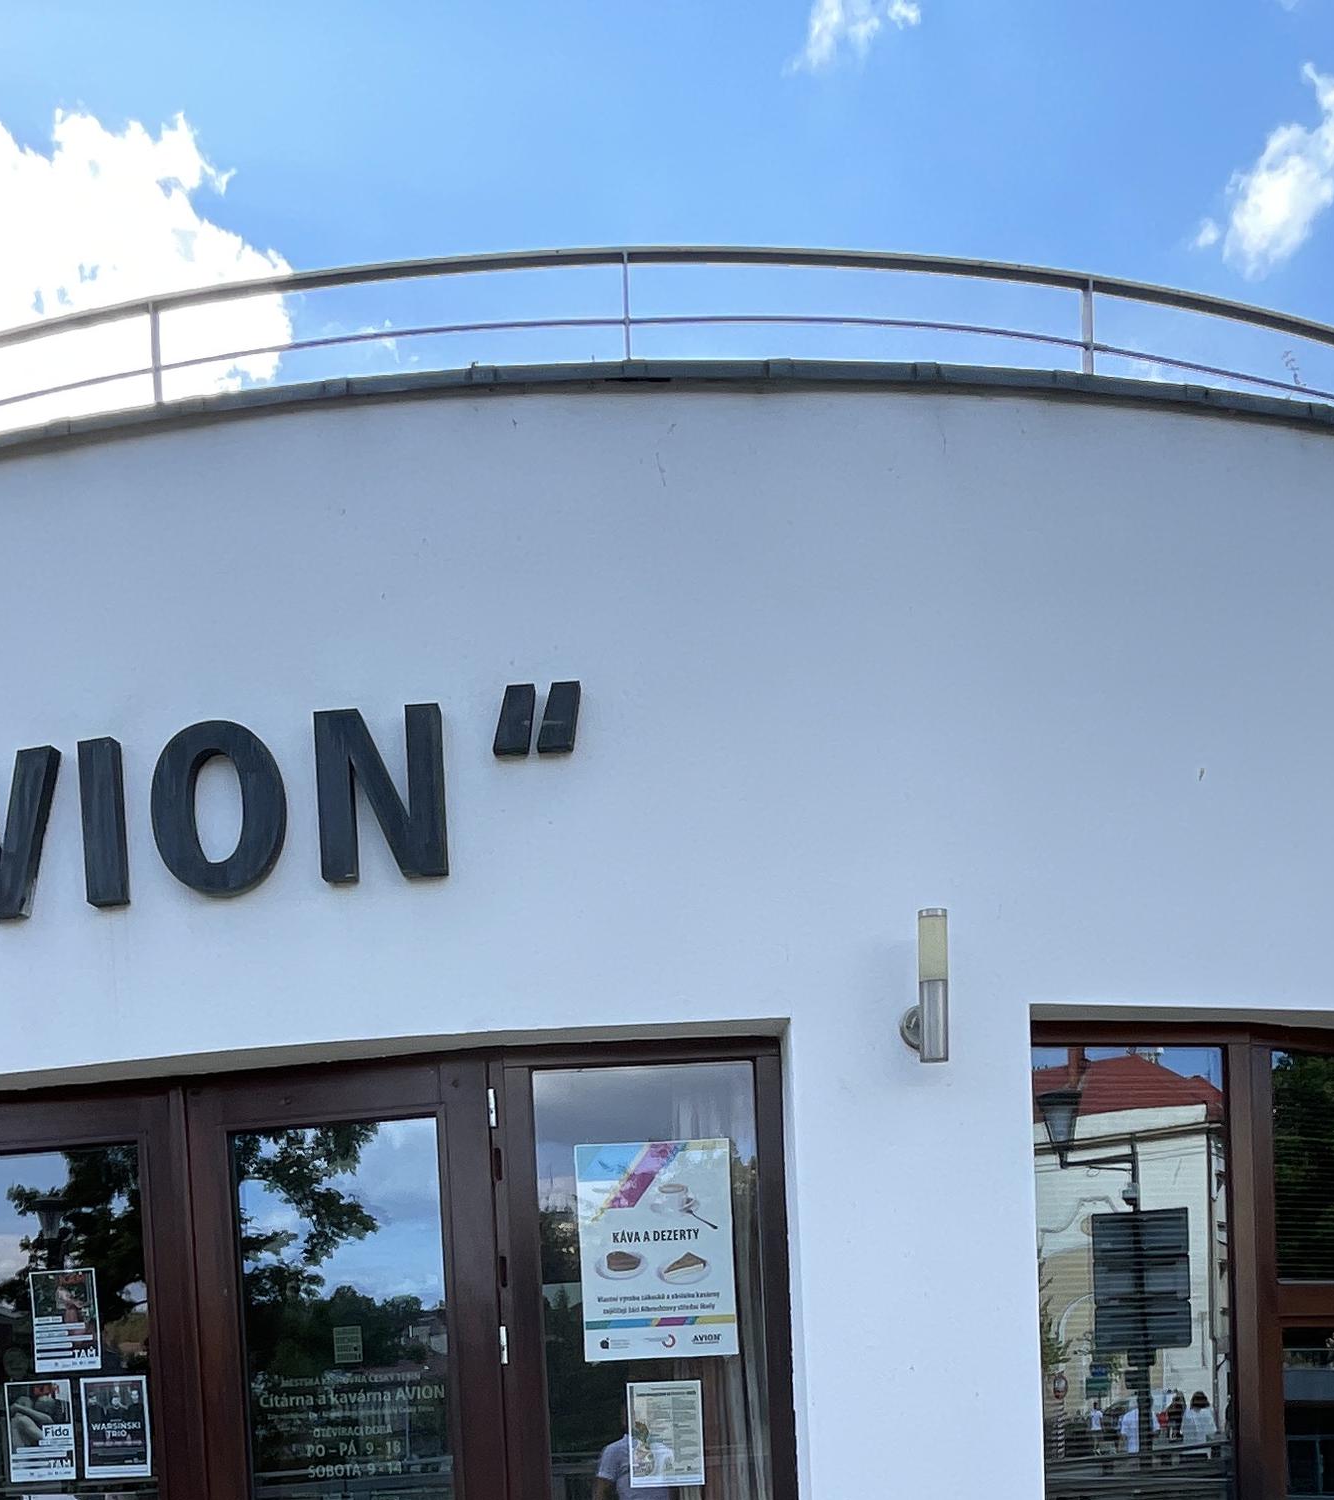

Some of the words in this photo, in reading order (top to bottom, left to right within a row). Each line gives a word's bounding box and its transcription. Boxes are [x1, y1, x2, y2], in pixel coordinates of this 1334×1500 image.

[612, 1229, 641, 1243] KÁVA
[643, 1230, 651, 1241] A
[653, 1228, 700, 1241] DEZERTY
[318, 1394, 327, 1405] a
[395, 1385, 445, 1400] AVION
[307, 1444, 325, 1457] PO
[339, 1440, 357, 1456] PÁ
[366, 1443, 374, 1455] 9
[308, 1464, 362, 1478] SOBOTA
[366, 1462, 376, 1475] 9
